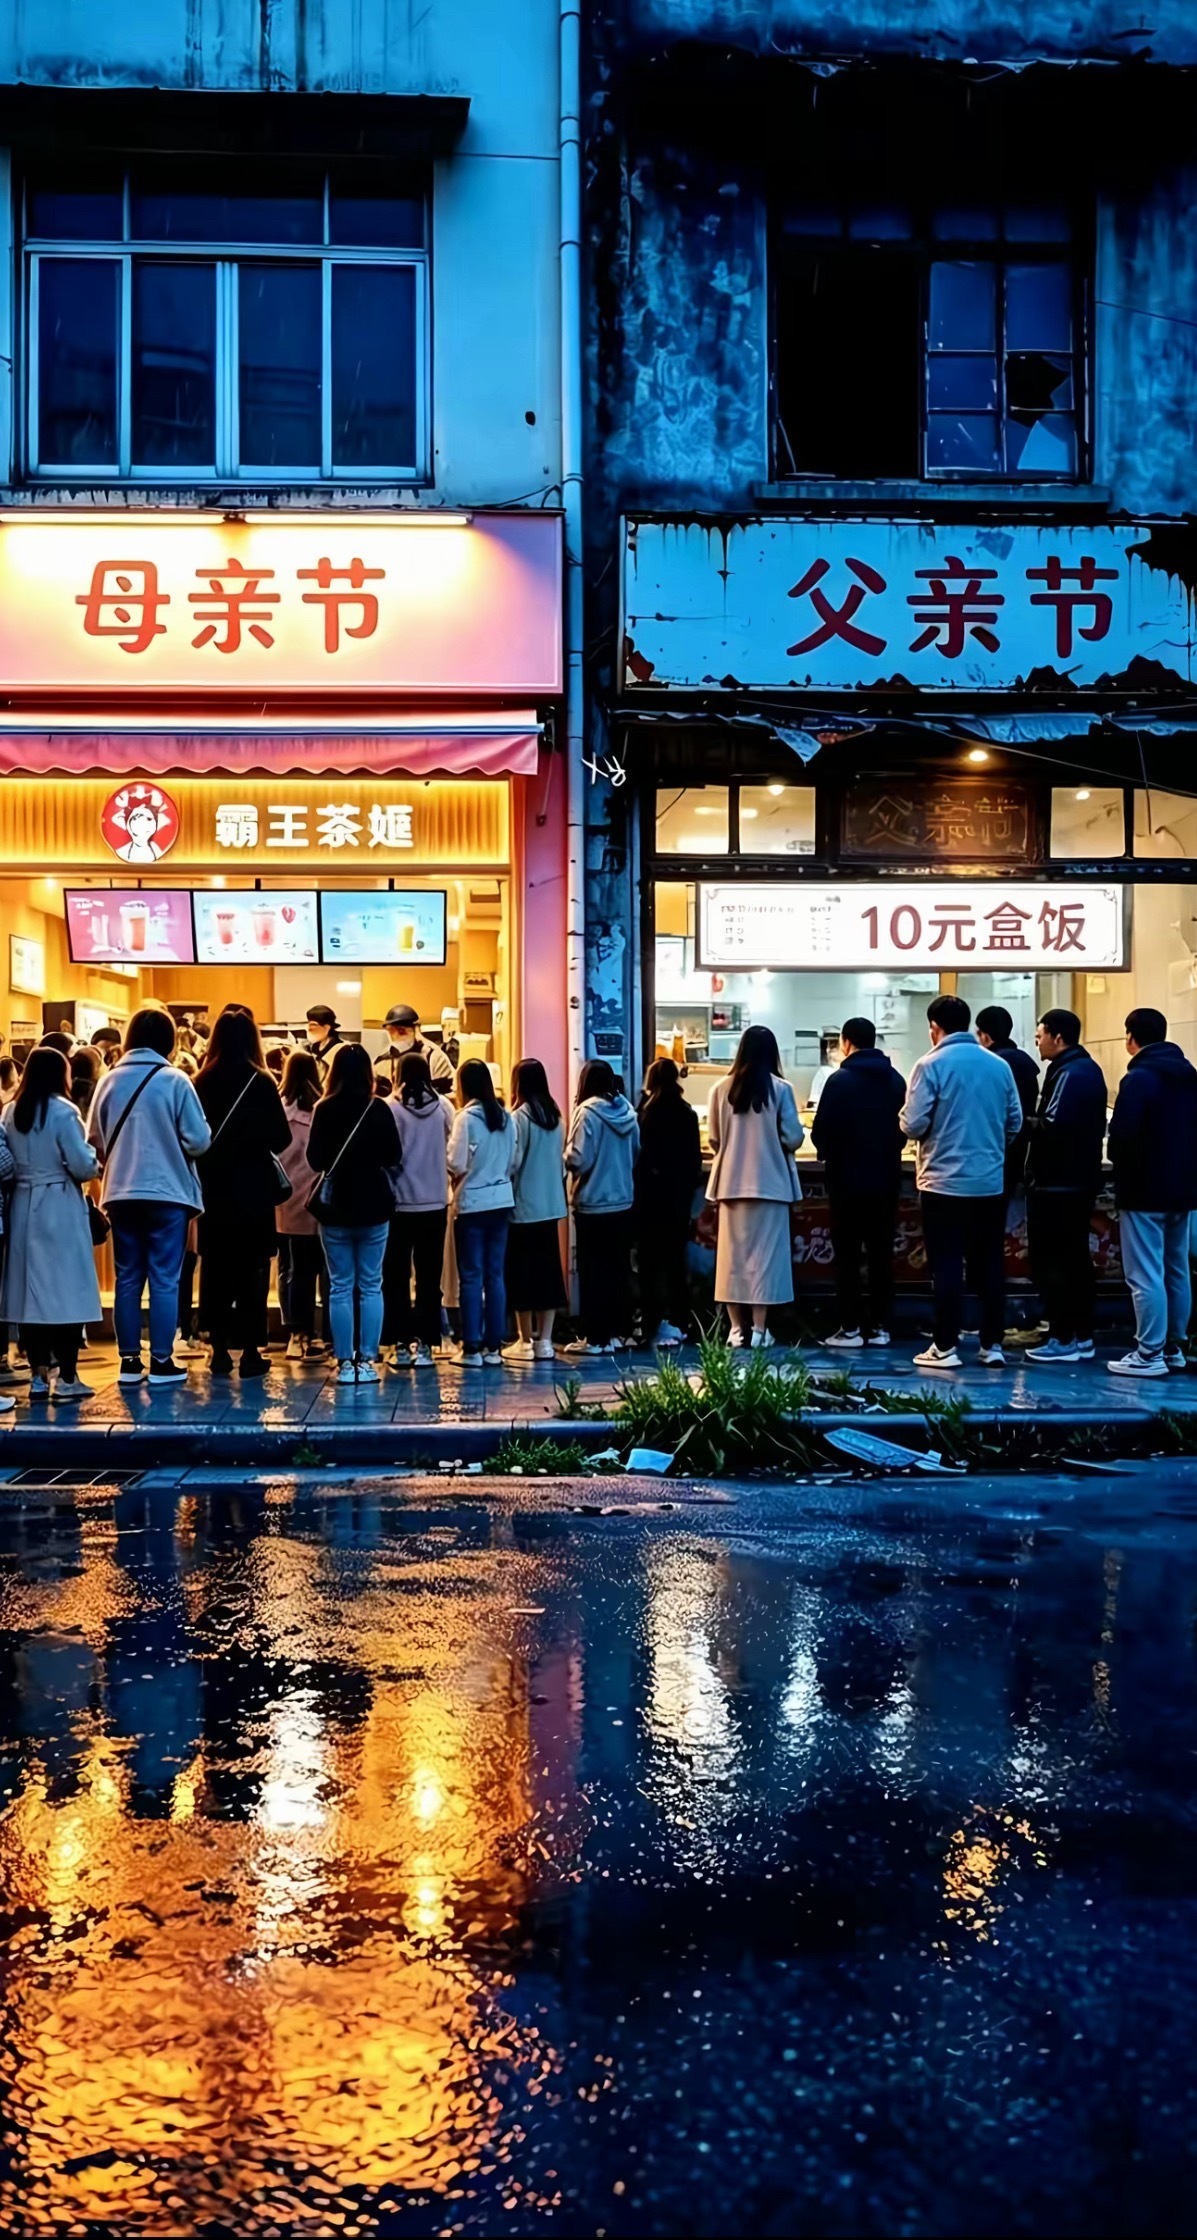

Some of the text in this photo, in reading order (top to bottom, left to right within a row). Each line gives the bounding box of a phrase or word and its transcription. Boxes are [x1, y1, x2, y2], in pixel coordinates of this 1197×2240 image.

[75, 557, 386, 654] 母亲节
[785, 555, 1120, 660] 父亲节
[861, 900, 1087, 952] 10元盒饭
